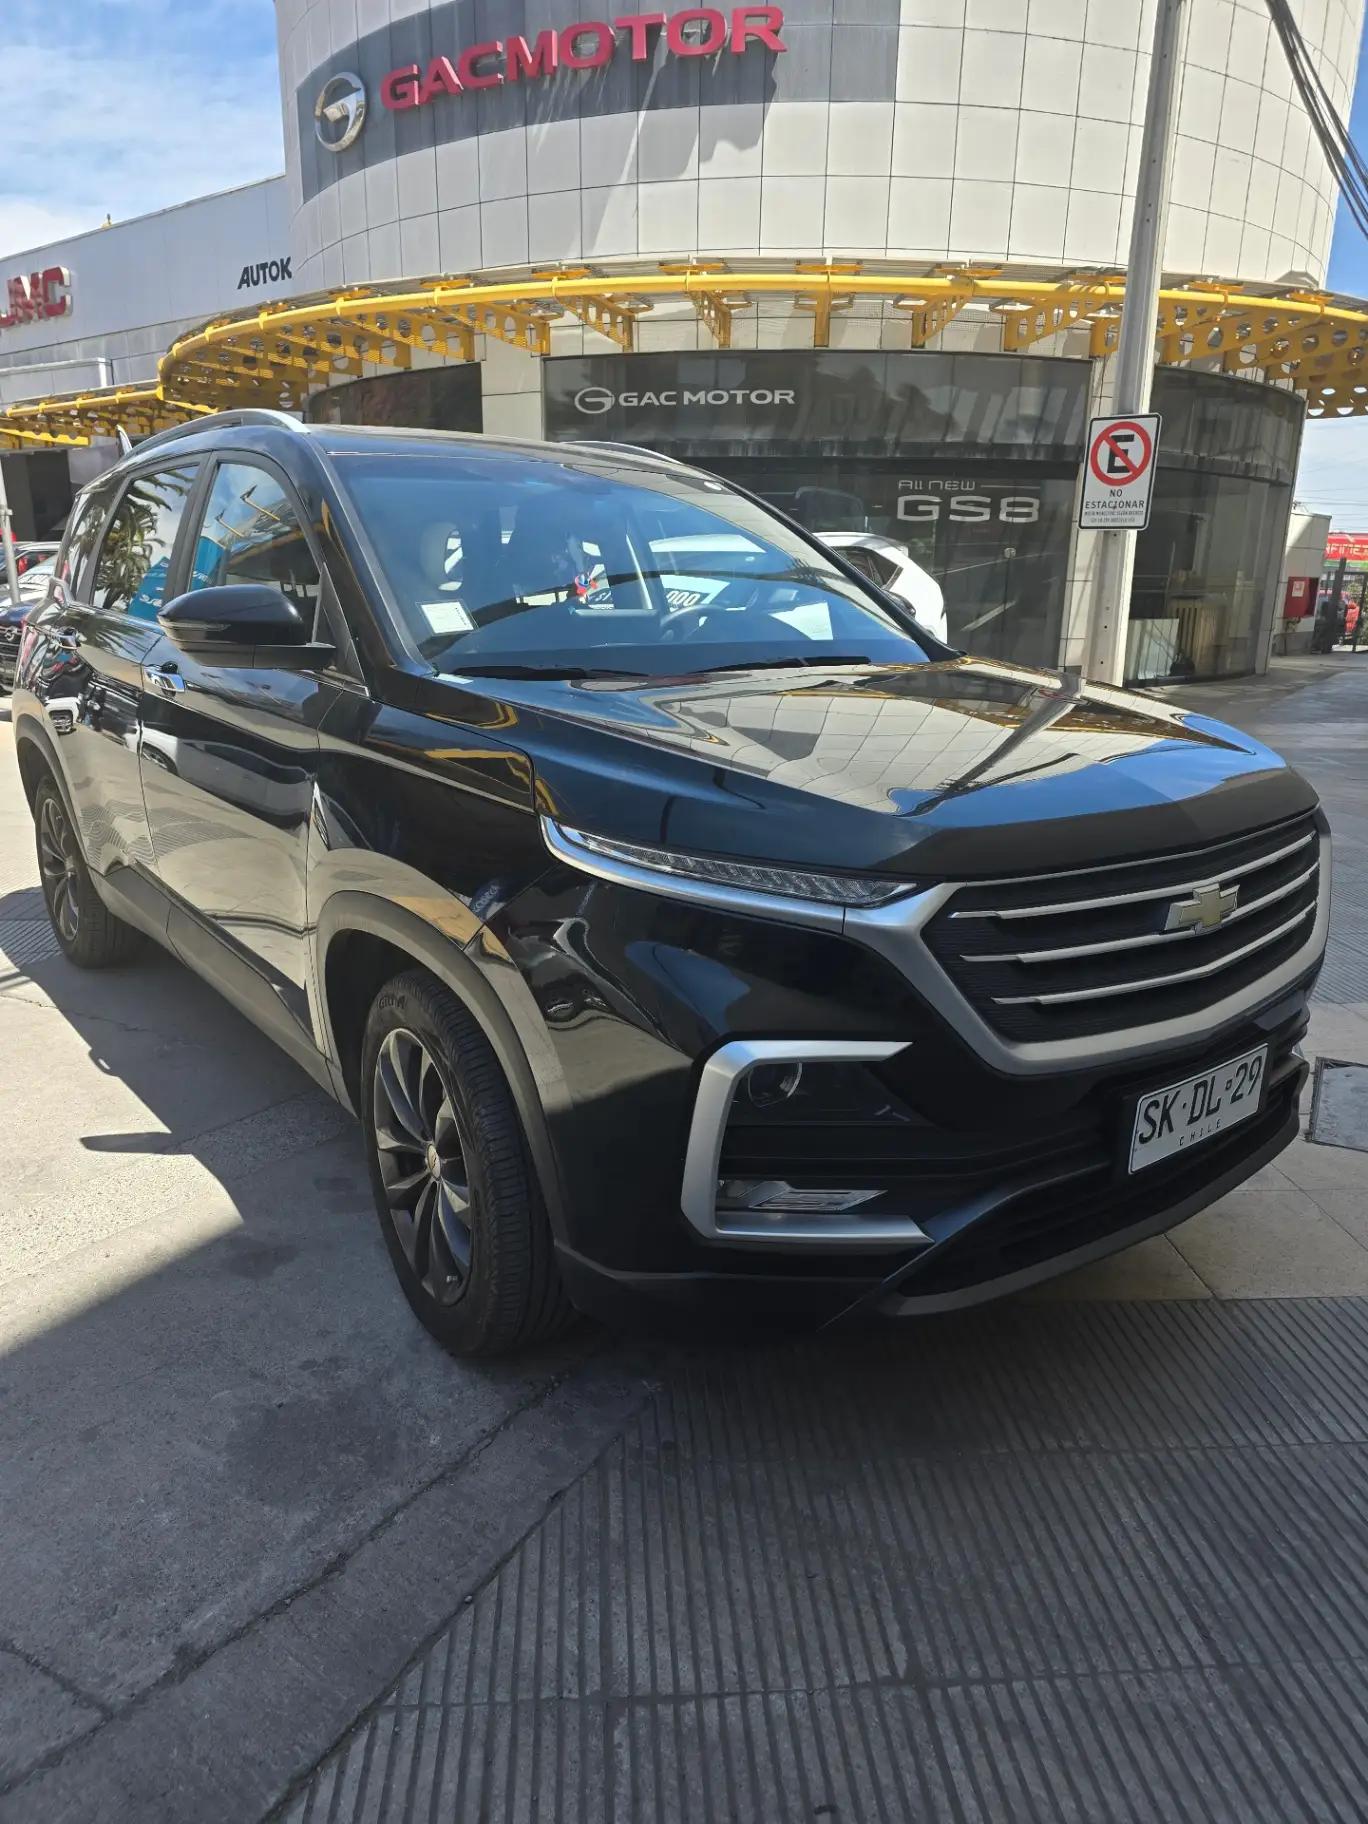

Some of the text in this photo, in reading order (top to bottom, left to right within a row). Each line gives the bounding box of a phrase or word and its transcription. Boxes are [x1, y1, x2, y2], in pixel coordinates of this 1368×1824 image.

[618, 389, 795, 407] GAC MOTOR
[1109, 489, 1123, 498] NO
[897, 494, 1040, 524] GS8
[1085, 500, 1145, 510] ESTACIONAR
[1179, 1119, 1221, 1146] CHILE
